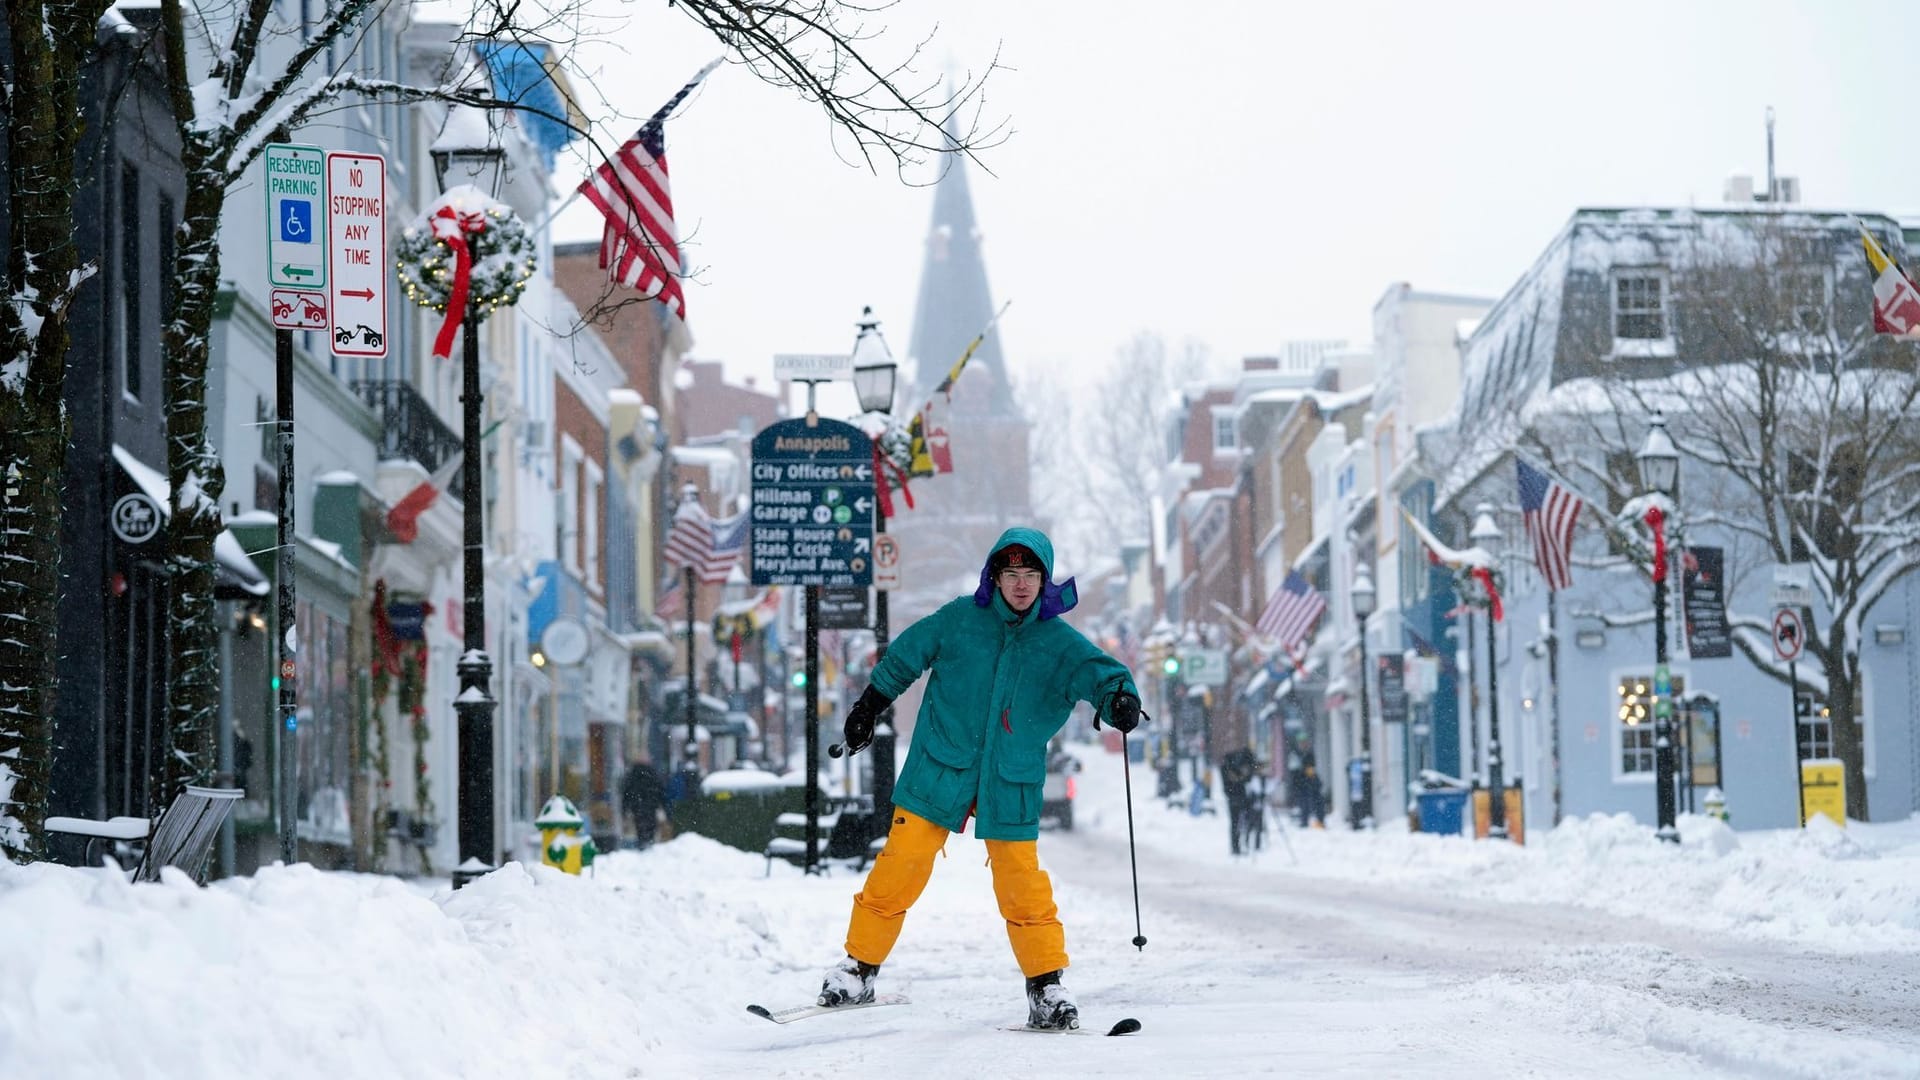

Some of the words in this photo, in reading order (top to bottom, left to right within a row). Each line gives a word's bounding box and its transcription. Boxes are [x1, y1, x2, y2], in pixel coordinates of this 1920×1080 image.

[269, 157, 321, 175] RESERVED
[272, 178, 317, 196] PARKING
[350, 169, 363, 188] NO
[333, 196, 380, 217] STOPPING
[345, 225, 370, 240] ANY
[344, 249, 371, 265] TIME
[775, 436, 849, 453] Annapolis
[754, 464, 783, 482] City
[787, 464, 839, 480] Offices
[754, 488, 811, 504] Hillman
[754, 505, 807, 523] Garage
[754, 528, 789, 542] State
[793, 528, 835, 541] House
[754, 543, 789, 557] State
[793, 543, 832, 557] Circle
[754, 558, 817, 573] Maryland
[820, 558, 849, 571] Ave.
